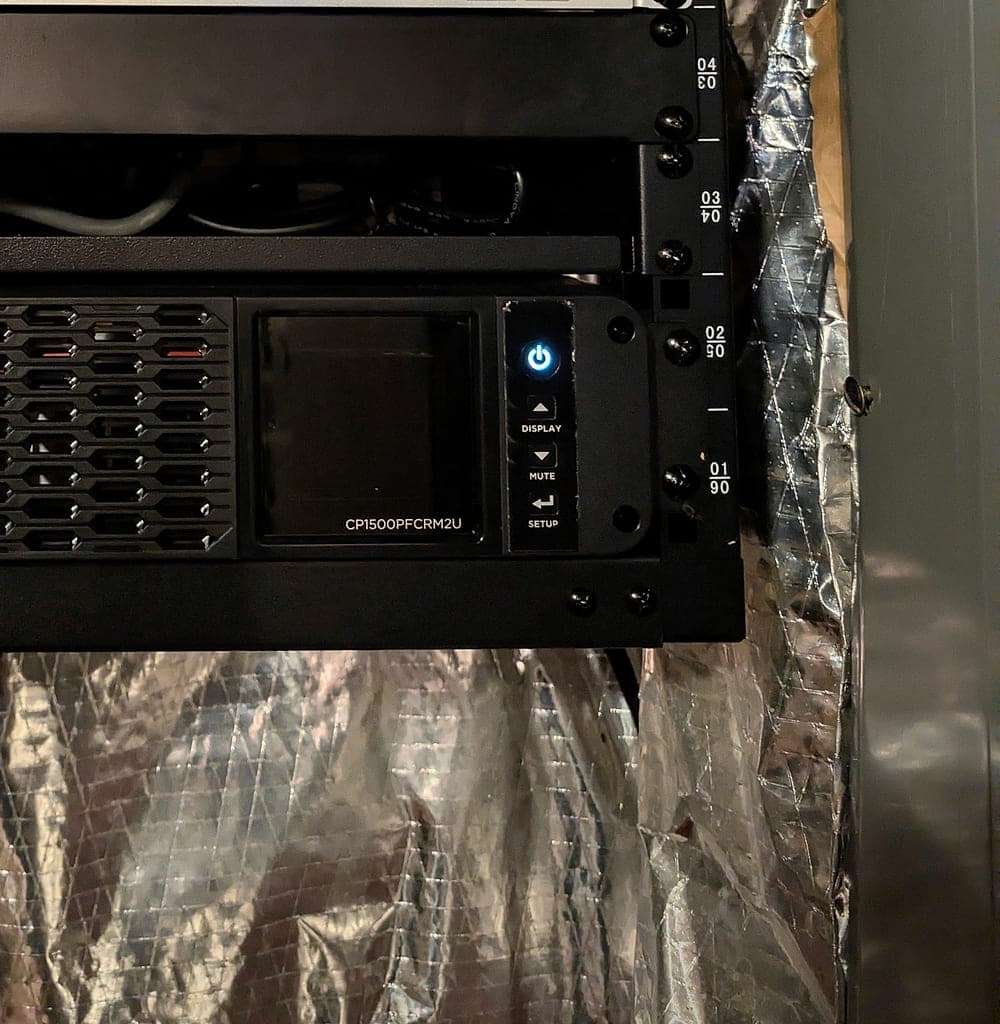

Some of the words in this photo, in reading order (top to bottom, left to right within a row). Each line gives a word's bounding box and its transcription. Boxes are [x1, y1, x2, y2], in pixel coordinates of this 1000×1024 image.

[697, 57, 717, 71] 04
[701, 191, 721, 205] 03
[705, 325, 725, 339] 02
[521, 424, 562, 433] DISPLAY
[710, 461, 728, 476] 01
[529, 472, 556, 481] MUTE
[345, 518, 462, 531] CP1500PFCRM2U
[528, 519, 559, 528] SETUP
